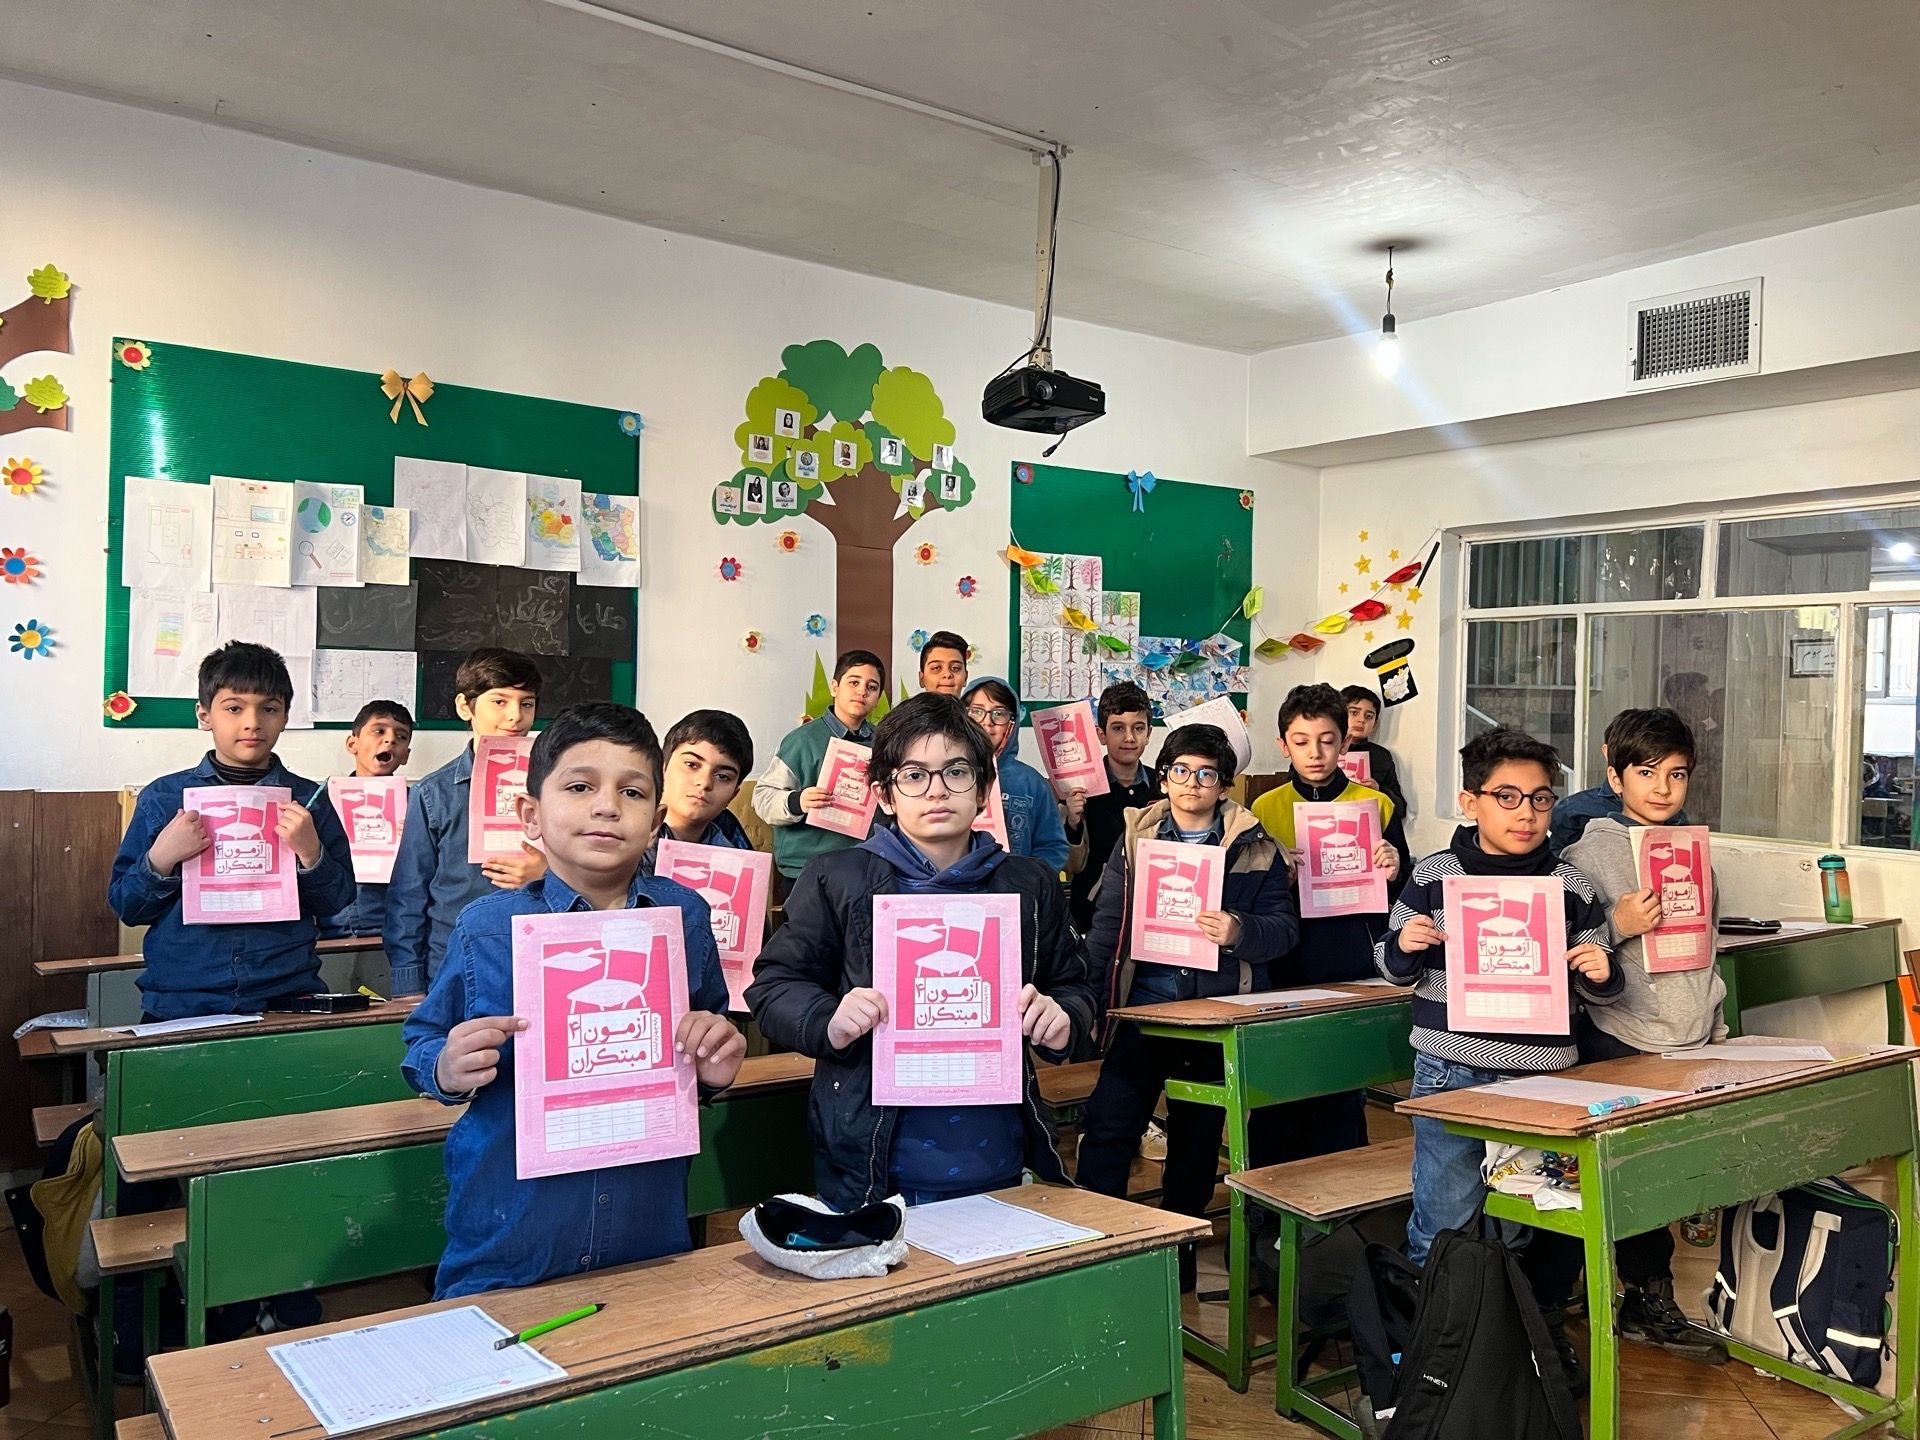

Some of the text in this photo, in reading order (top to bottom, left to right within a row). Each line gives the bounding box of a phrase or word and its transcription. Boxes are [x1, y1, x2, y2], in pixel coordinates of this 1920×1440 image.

[215, 844, 223, 855] ۴
[224, 841, 264, 858] آزمون
[1329, 848, 1359, 862] آزمون
[216, 860, 263, 874] مبتکران
[1323, 863, 1360, 875] مبتکران
[1164, 893, 1195, 905] آزمون
[1667, 883, 1694, 900] آزمون
[1157, 907, 1193, 920] مبتکران
[1663, 902, 1695, 917] مبتکران
[710, 912, 733, 930] آزم
[1479, 938, 1531, 955] آزمون ۴
[1480, 958, 1531, 974] مبتکران
[915, 978, 981, 1004] آزمون ۴
[916, 1005, 978, 1027] مبتکران
[569, 1010, 650, 1044] آزمون ۴
[570, 1047, 648, 1075] مبتکران
